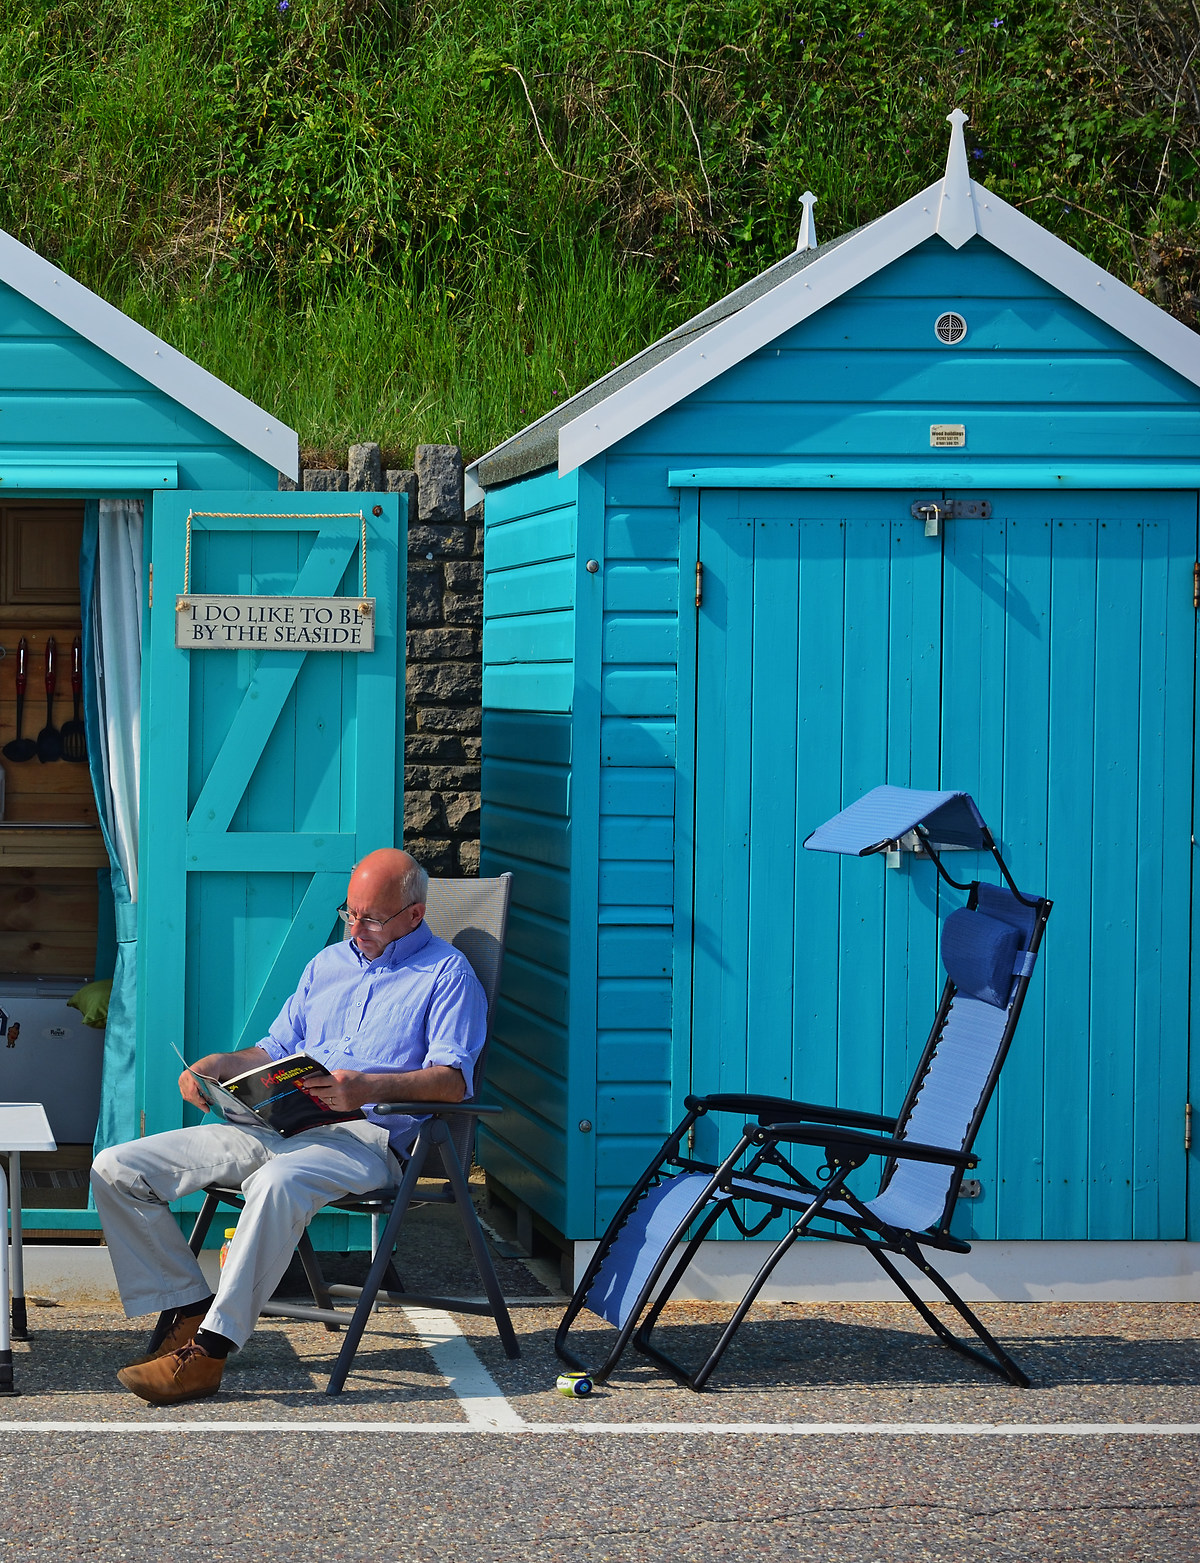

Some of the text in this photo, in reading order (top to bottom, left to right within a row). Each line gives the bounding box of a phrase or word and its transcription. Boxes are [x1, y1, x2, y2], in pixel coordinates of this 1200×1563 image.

[190, 605, 365, 626] I DO LIKE TO BE
[192, 624, 362, 645] BY THE SEASIDE
